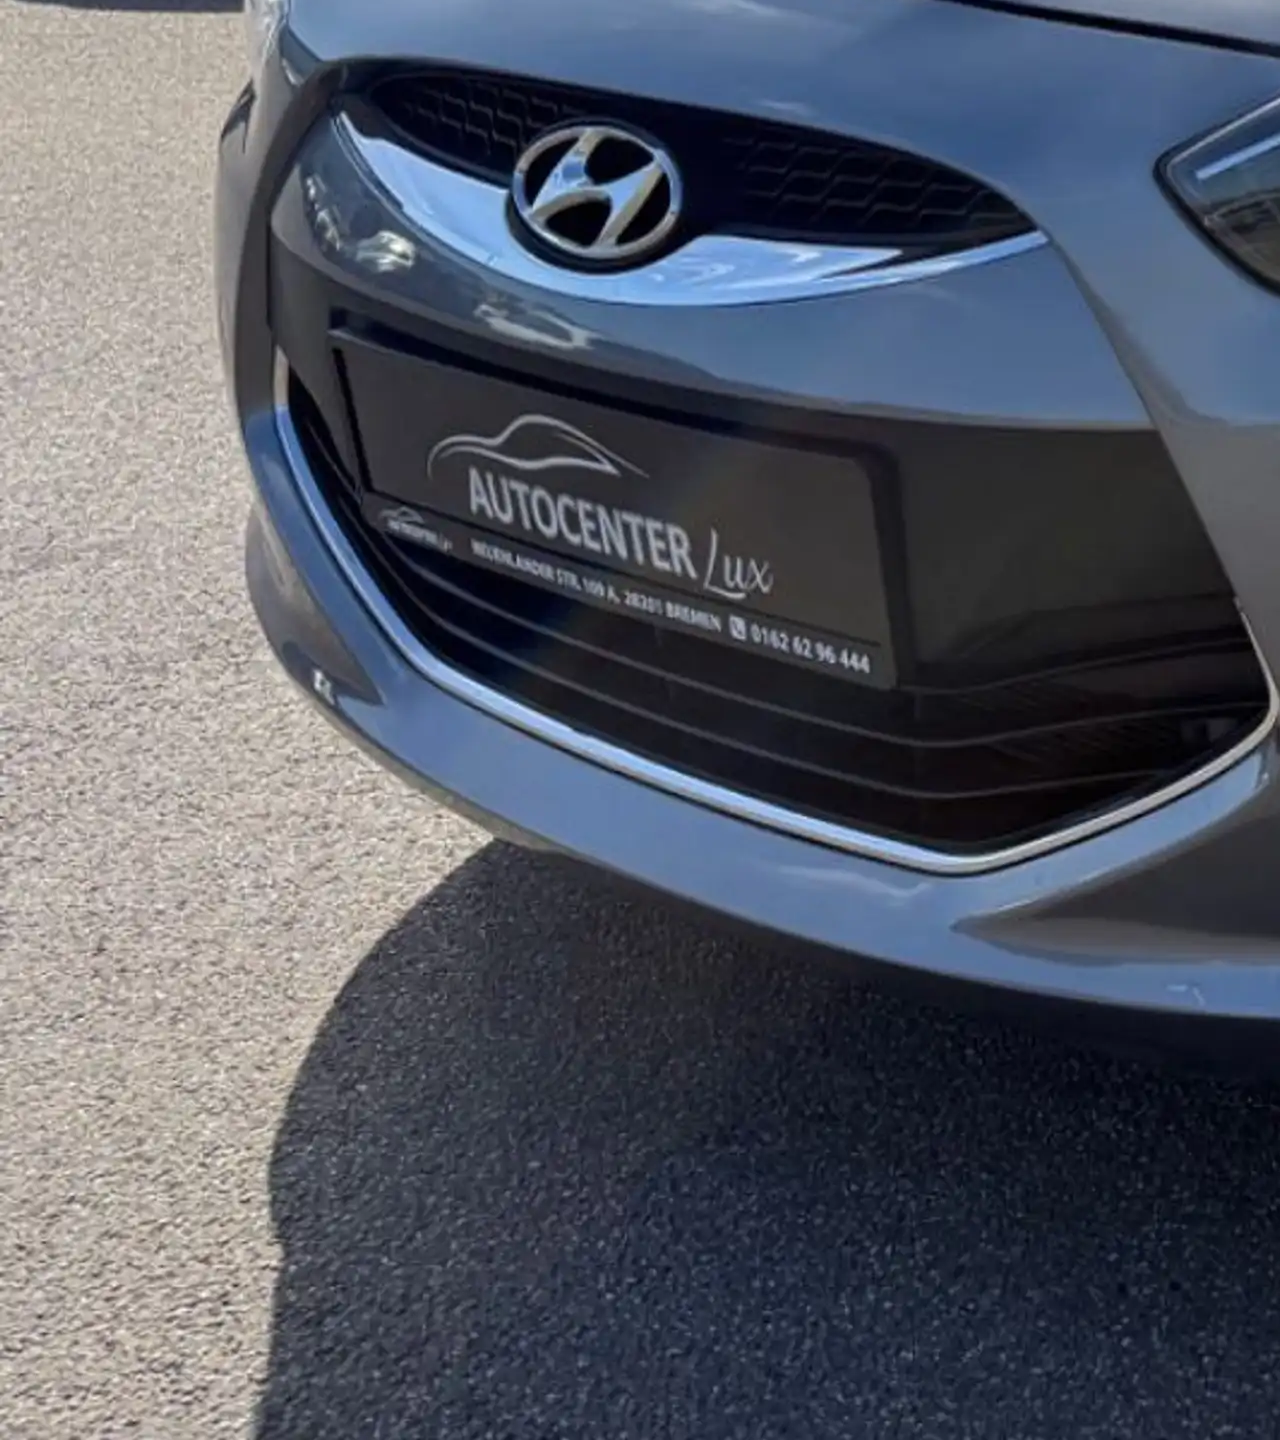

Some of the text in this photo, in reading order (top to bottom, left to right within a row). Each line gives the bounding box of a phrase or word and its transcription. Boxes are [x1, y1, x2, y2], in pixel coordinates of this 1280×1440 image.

[468, 466, 774, 600] AUTOCENTER Lux
[751, 625, 789, 653] 0162
